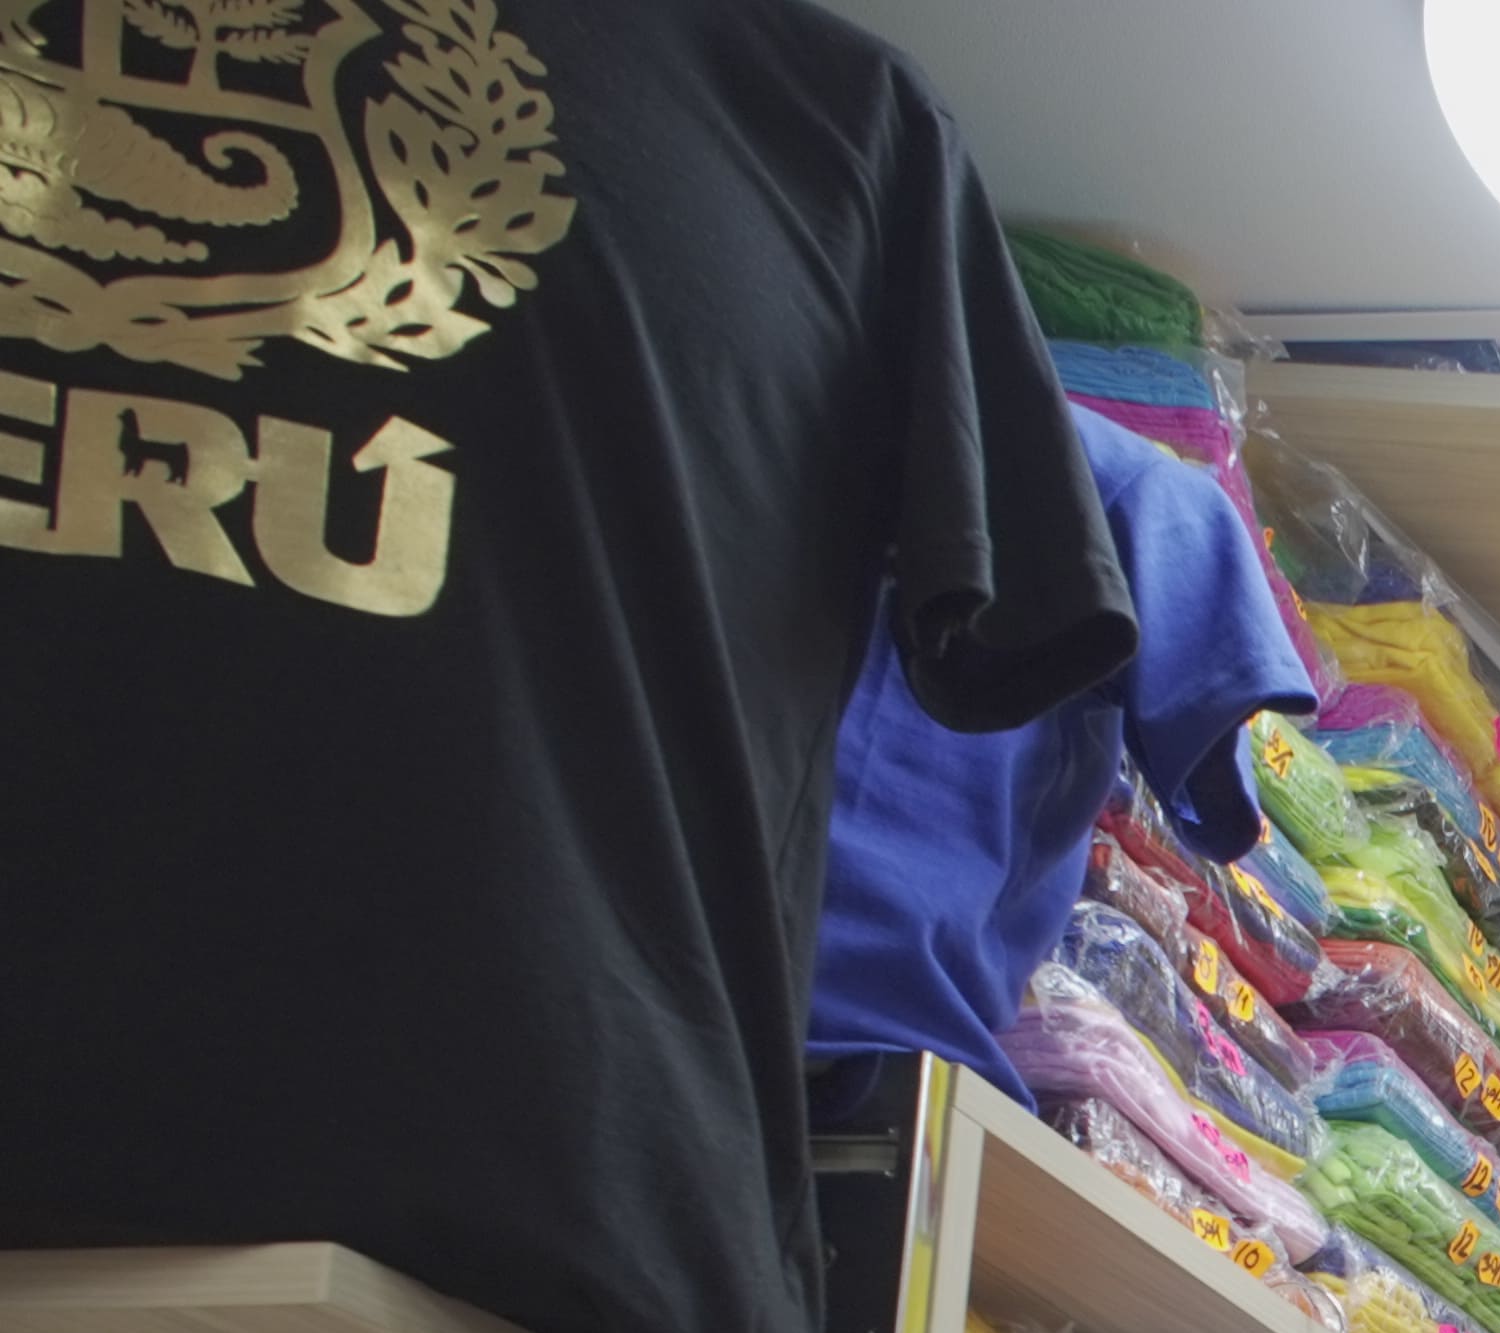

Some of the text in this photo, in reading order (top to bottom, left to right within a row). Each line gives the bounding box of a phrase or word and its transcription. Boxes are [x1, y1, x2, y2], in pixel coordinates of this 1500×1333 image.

[1455, 1056, 1476, 1094] 12
[1461, 1160, 1490, 1191] 12
[1233, 1241, 1261, 1270] 10
[1452, 1227, 1474, 1259] 12
